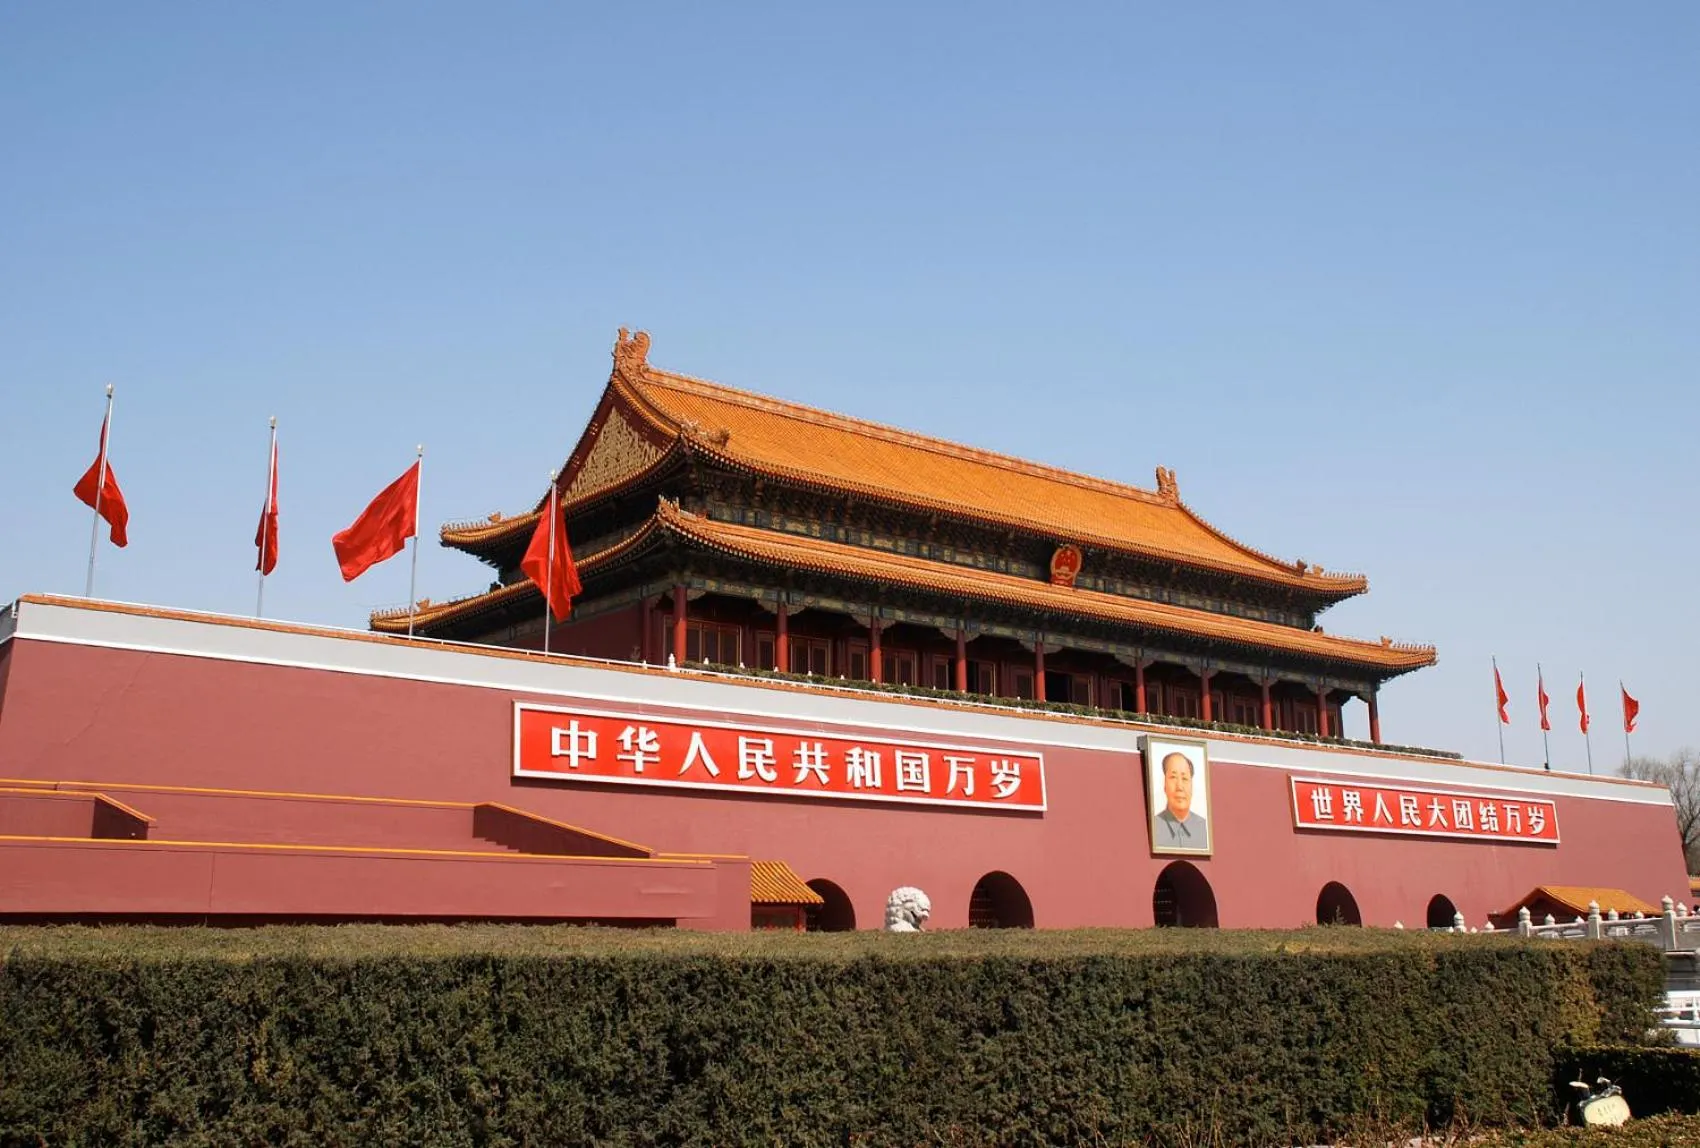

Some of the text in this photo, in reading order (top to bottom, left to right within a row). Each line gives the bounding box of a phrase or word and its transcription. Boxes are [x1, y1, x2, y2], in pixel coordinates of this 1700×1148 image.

[551, 720, 1022, 798] 中华人民共和国万岁
[1310, 786, 1546, 835] 世界人民大团结万岁
